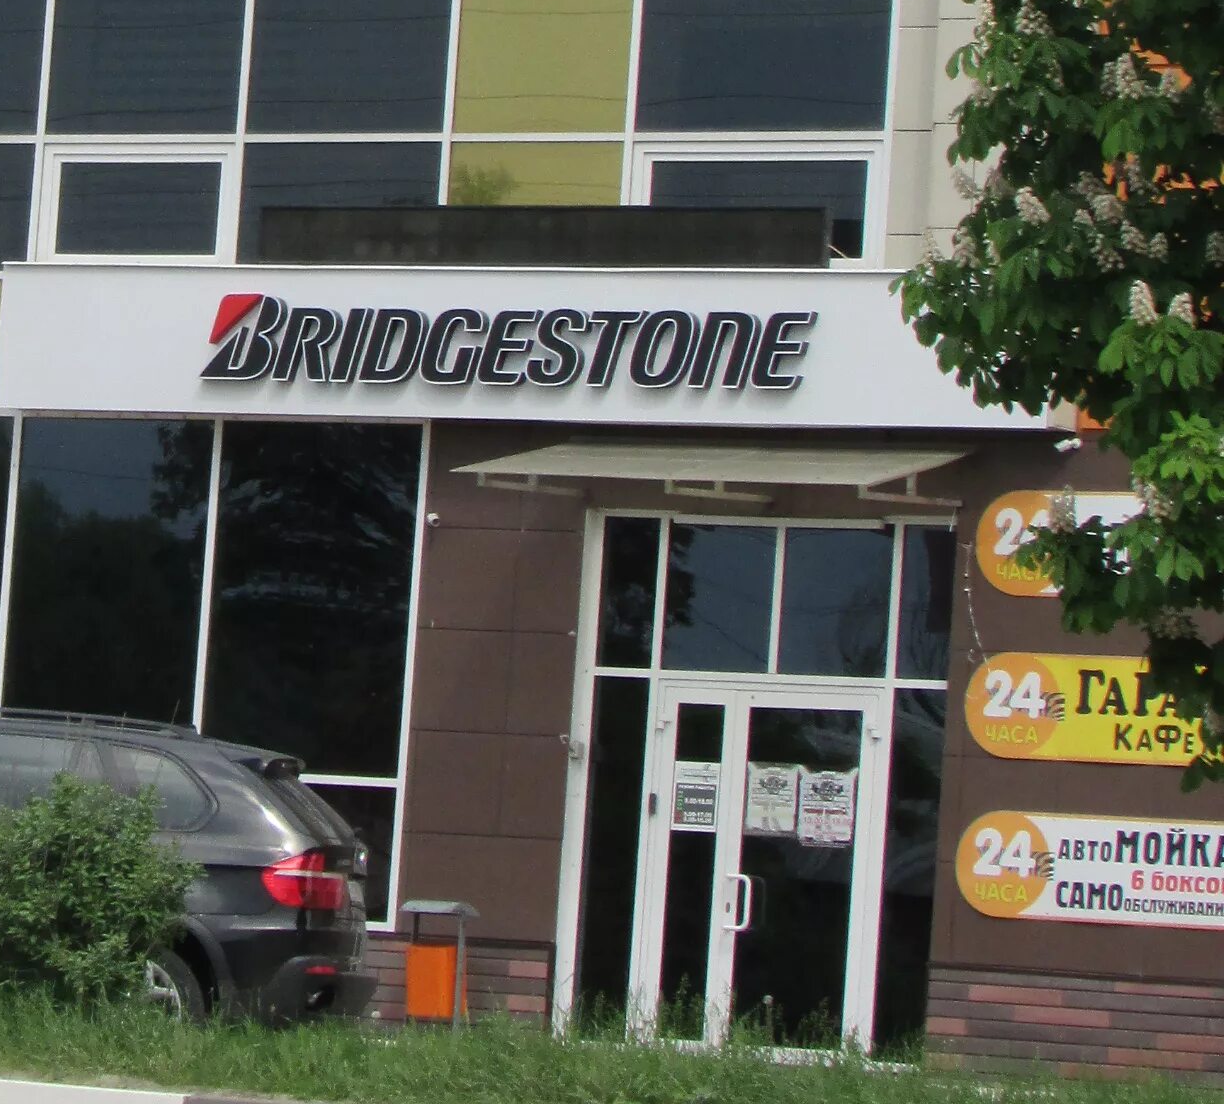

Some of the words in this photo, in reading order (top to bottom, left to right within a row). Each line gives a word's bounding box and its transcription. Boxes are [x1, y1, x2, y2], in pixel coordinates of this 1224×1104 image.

[200, 293, 817, 390] BRIDGESTONE
[983, 669, 1046, 719] 24
[984, 723, 1038, 744] ЧАСА
[1113, 723, 1195, 754] КАФЕ
[972, 827, 1038, 878] 24
[975, 882, 1028, 903] ЧАСА
[1131, 870, 1145, 891] 6
[1151, 871, 1224, 894] боксо
